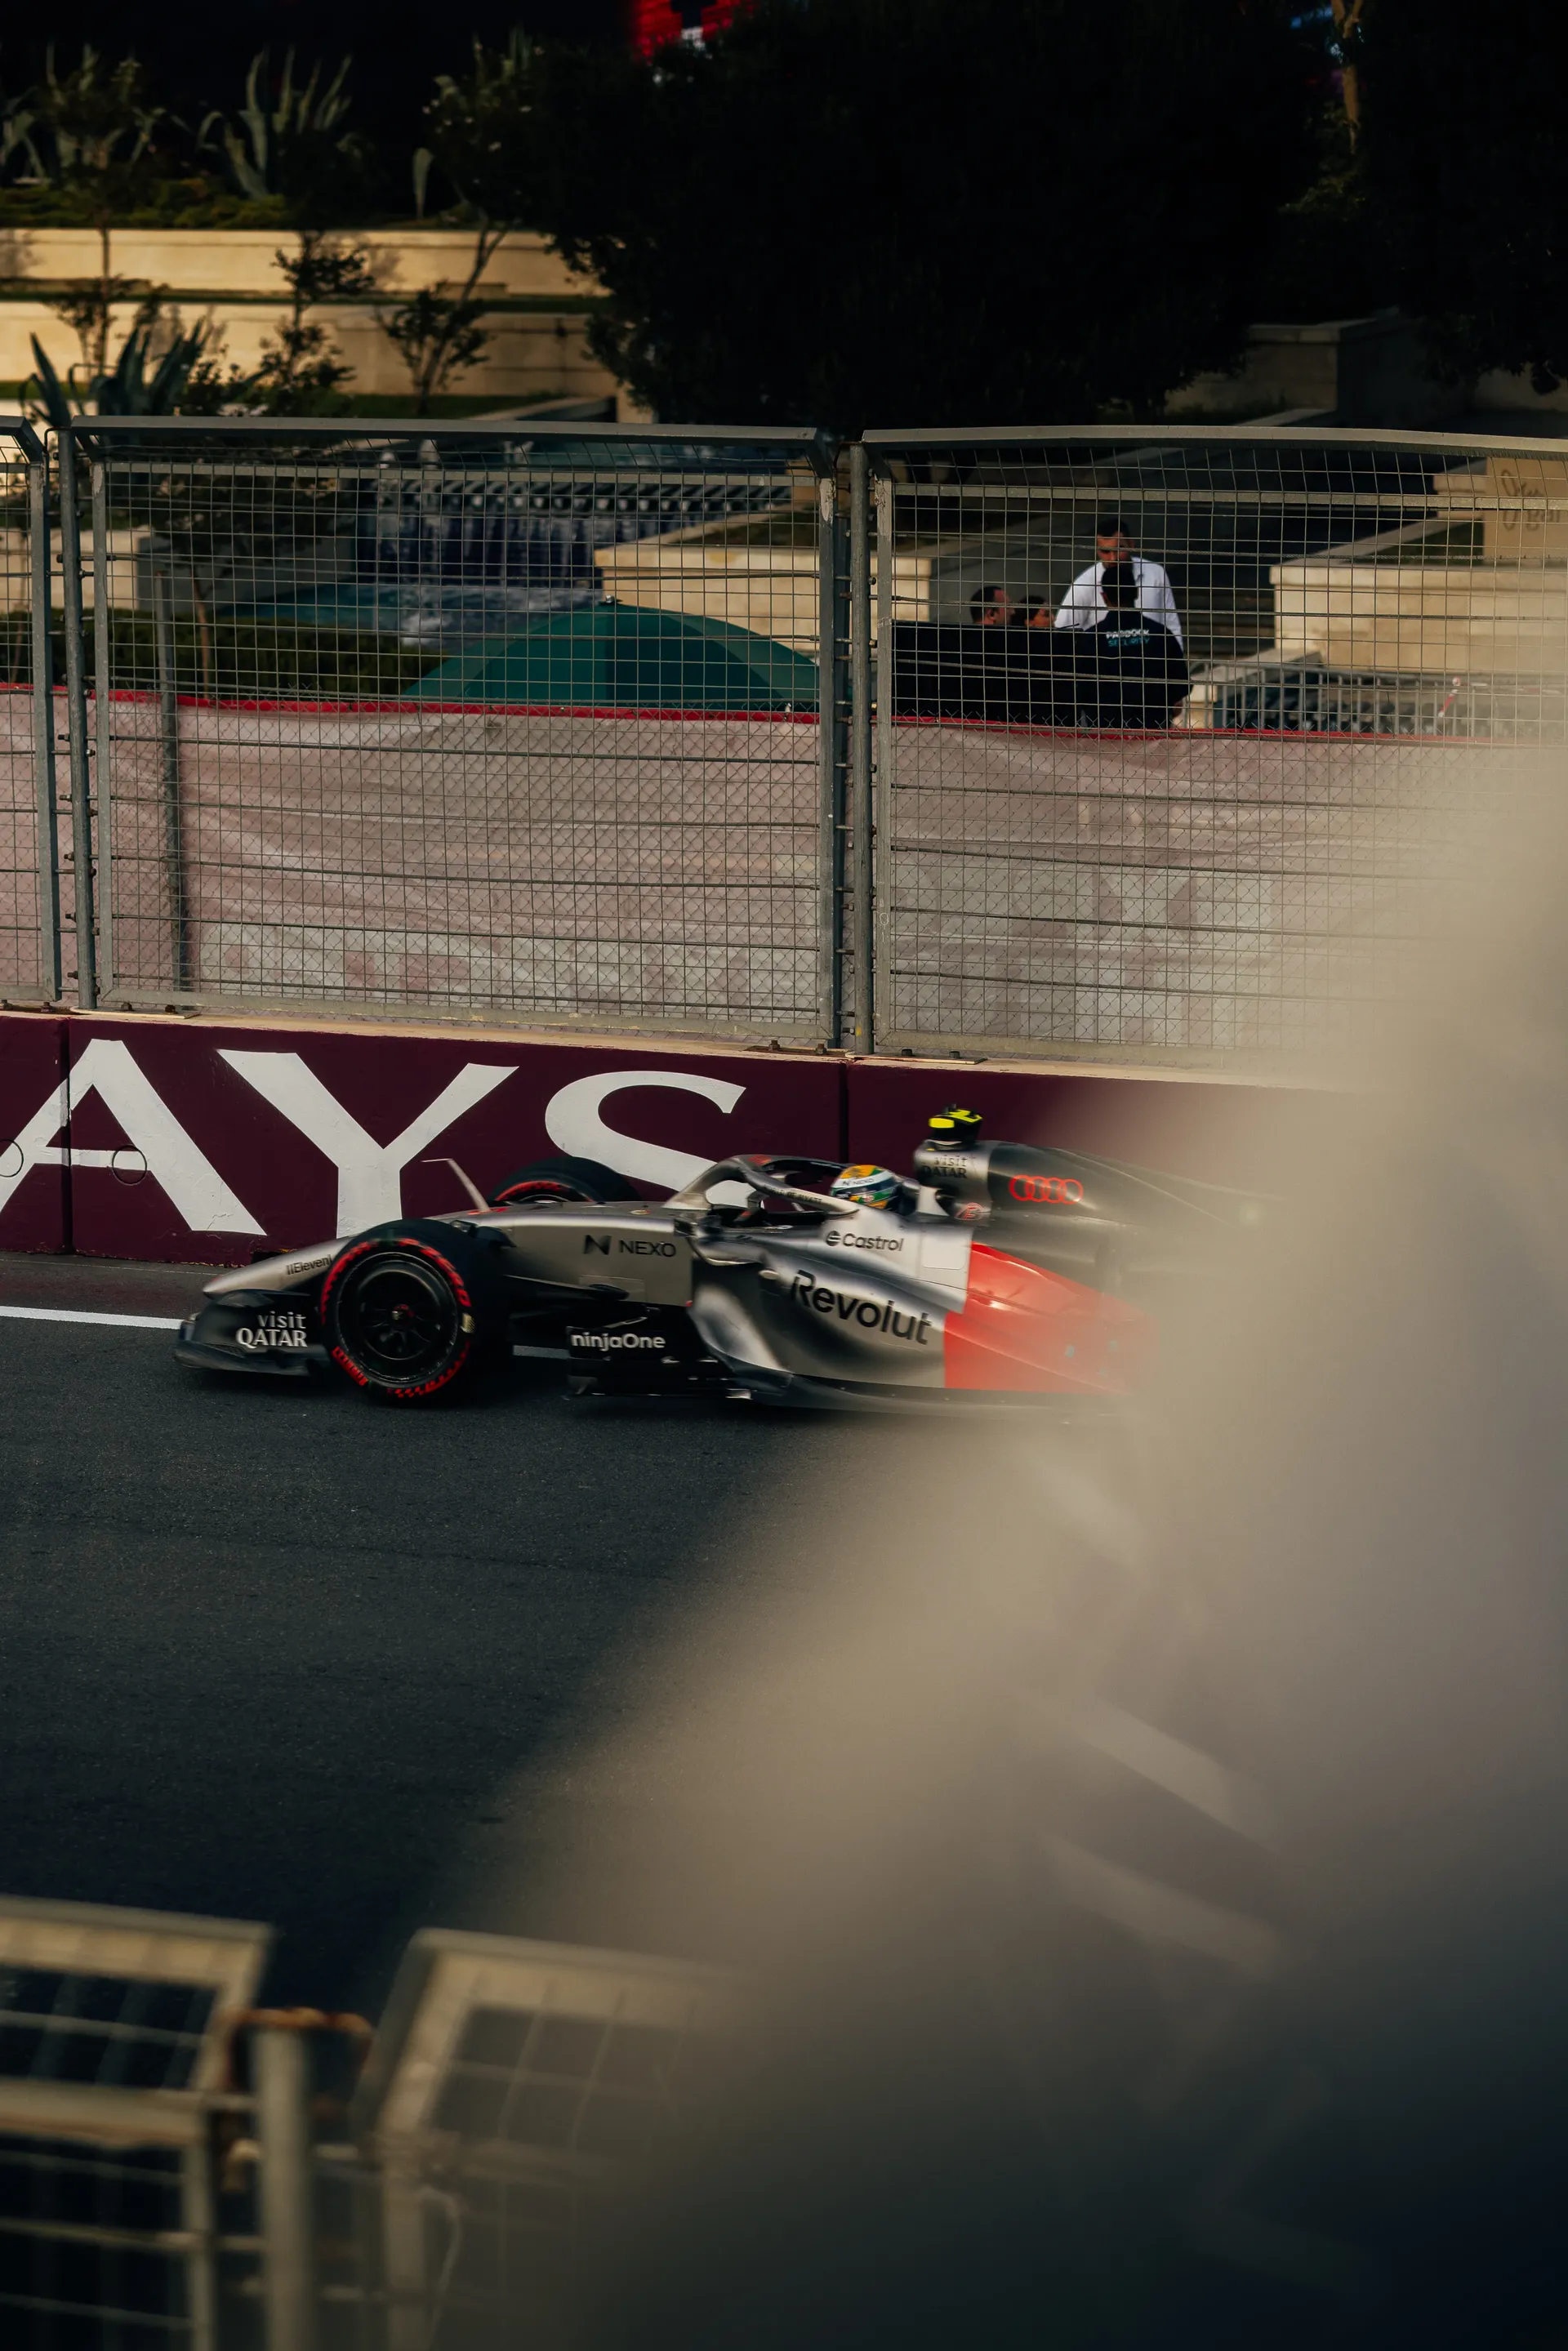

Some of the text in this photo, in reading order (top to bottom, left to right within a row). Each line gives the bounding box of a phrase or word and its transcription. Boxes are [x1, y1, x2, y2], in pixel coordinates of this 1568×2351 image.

[619, 1240, 676, 1257] NEXO
[843, 1232, 905, 1252] Castrol
[791, 1269, 933, 1346] Revolut
[258, 1311, 306, 1329] visit
[235, 1327, 308, 1348] QATAR
[572, 1332, 666, 1351] ninjaOne
